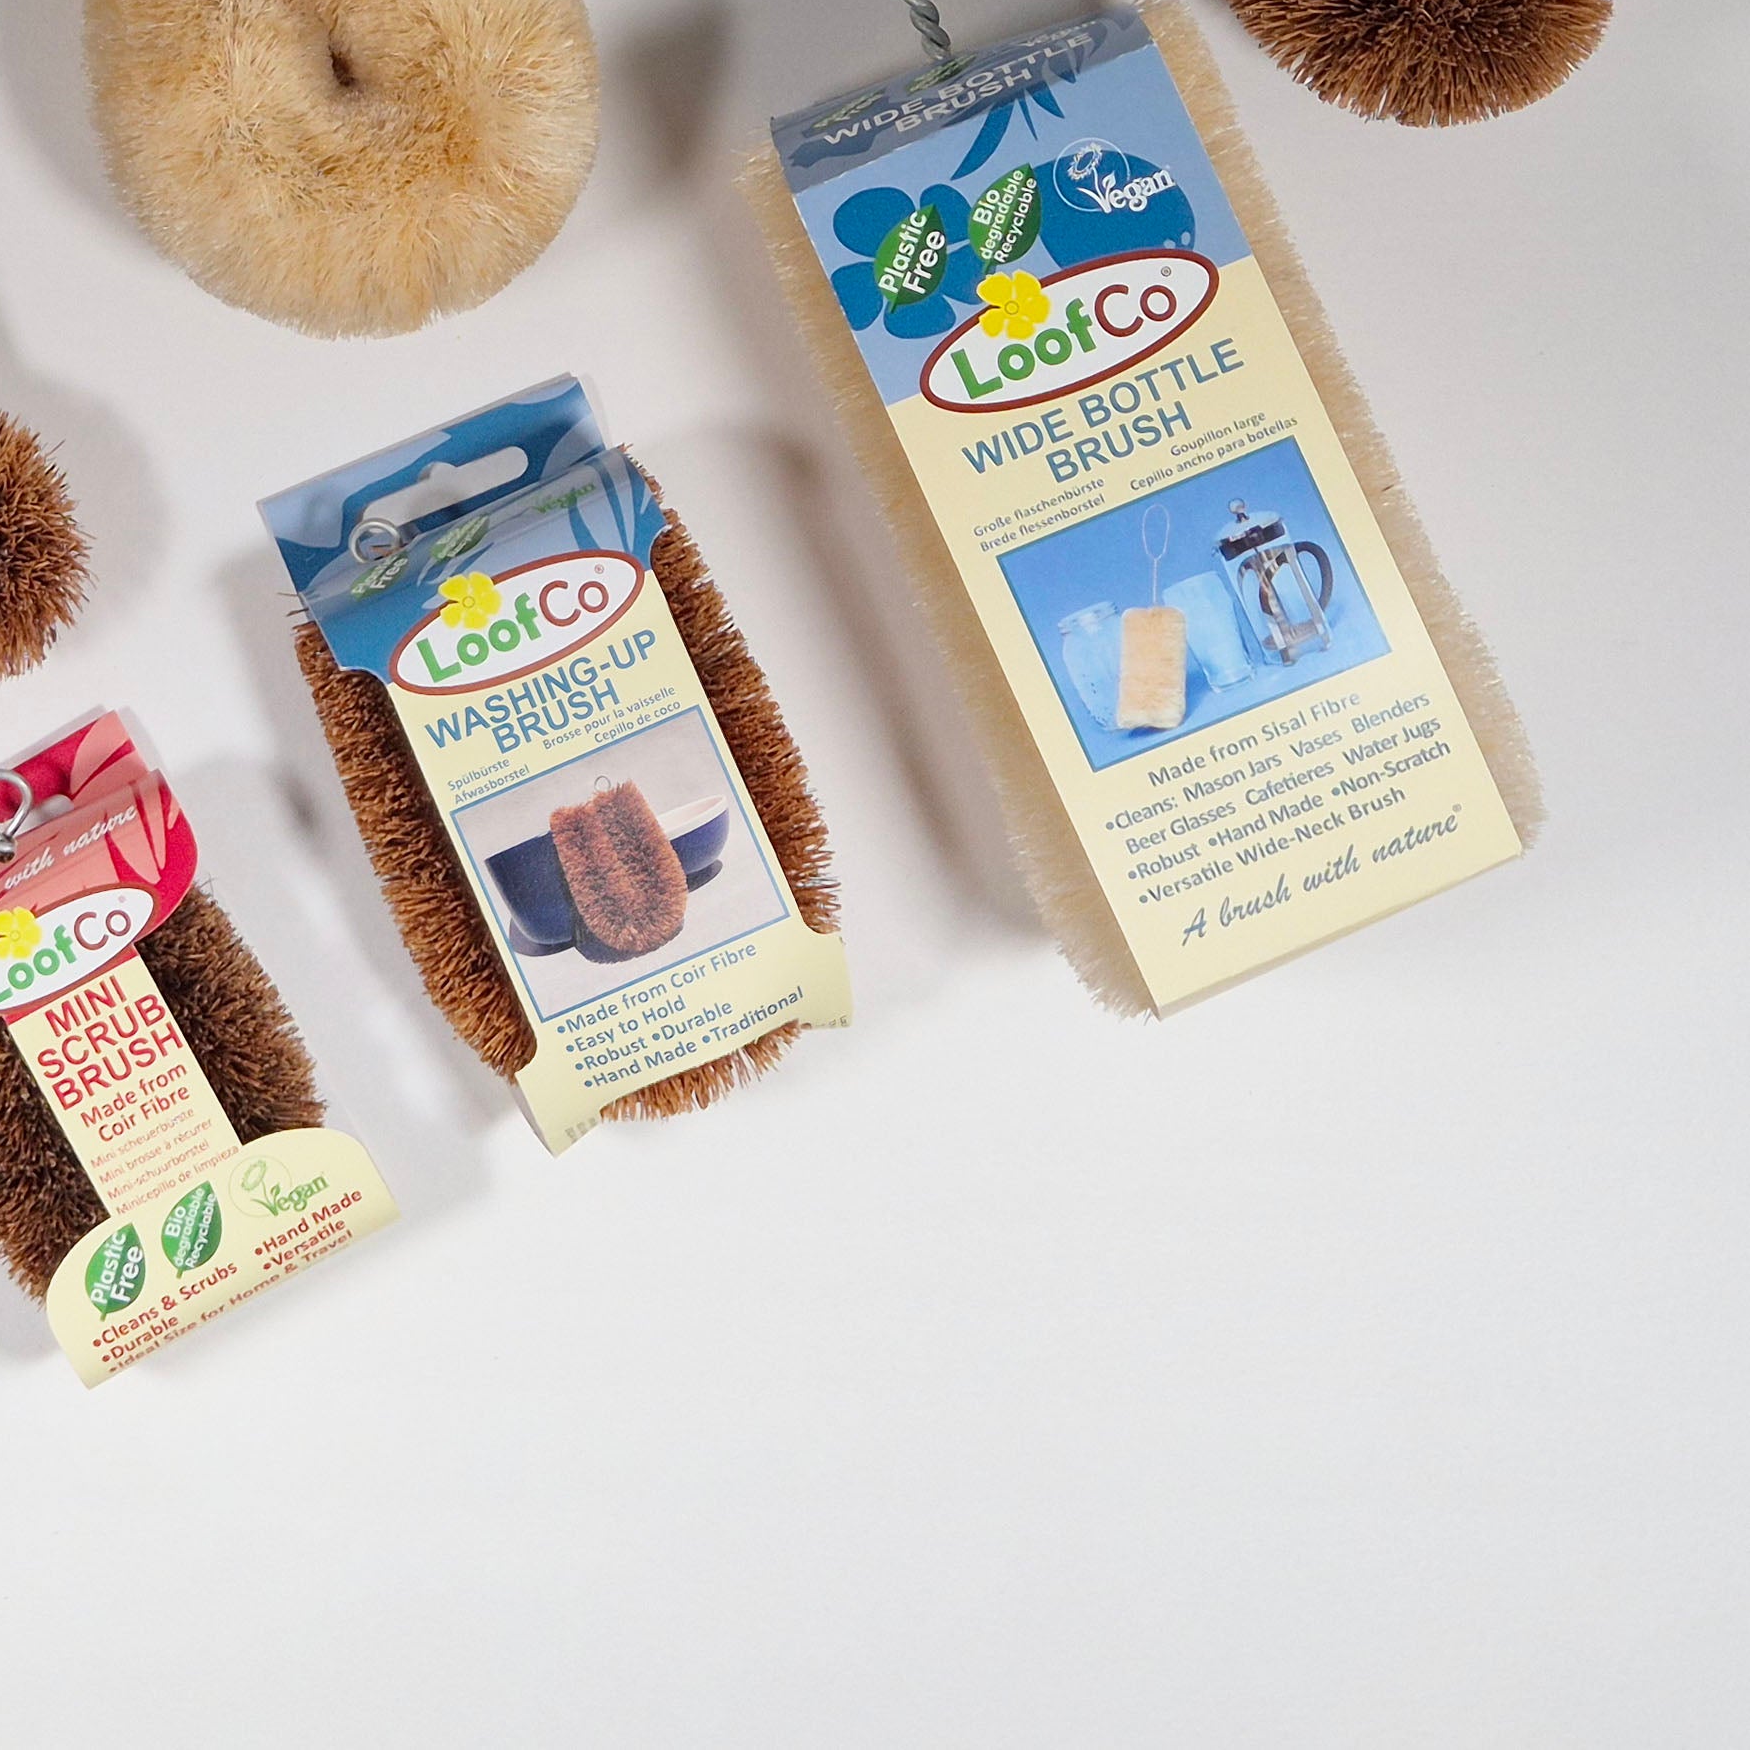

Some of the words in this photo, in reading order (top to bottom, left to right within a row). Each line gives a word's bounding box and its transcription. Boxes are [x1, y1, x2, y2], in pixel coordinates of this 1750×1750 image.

[822, 97, 925, 144] WIDE
[937, 32, 1092, 100] BOTTLE
[895, 68, 1032, 132] BRUSH
[972, 190, 1000, 225] Bio
[980, 170, 1024, 260] degradable
[1077, 157, 1175, 213] Vegan
[879, 211, 927, 293] Plastic
[994, 179, 1037, 263] Recyclable
[905, 230, 945, 294] Free
[961, 408, 1073, 473] WIDE
[1078, 338, 1243, 428] BOTTLE
[1170, 426, 1232, 456] Goupillon
[1232, 412, 1265, 431] large
[1045, 401, 1191, 482] BRUSH
[425, 629, 655, 747] WASHING-UP
[491, 678, 619, 753] BRUSH
[541, 727, 582, 750] Brosse
[583, 714, 611, 734] pour
[612, 708, 625, 719] la
[625, 686, 676, 713] vaisselle
[593, 721, 638, 749] Cepillo
[635, 713, 652, 726] de
[653, 701, 681, 718] coco
[1147, 755, 1206, 787] Made
[1209, 734, 1259, 763] from
[1260, 710, 1307, 742] Sisal
[1309, 694, 1360, 722] Fibre
[447, 758, 510, 791] Spülbürste
[454, 763, 530, 805] Afwasborstel
[1125, 828, 1167, 855] Beer
[1169, 801, 1236, 836] Glasses
[1244, 761, 1334, 805] Cafetieres
[1341, 734, 1398, 765] Water
[1401, 717, 1441, 743] Jugs
[0, 846, 55, 889] with
[62, 805, 138, 856] nature
[1181, 907, 1207, 947] A
[1219, 873, 1292, 927] brush
[1302, 843, 1361, 892] with
[44, 976, 125, 1037] MINI
[621, 983, 667, 1010] from
[669, 964, 706, 988] Coir
[709, 944, 757, 972] Fibre
[37, 994, 165, 1079] SCRUB
[52, 1022, 182, 1110] BRUSH
[80, 1090, 137, 1127] Made
[138, 1064, 187, 1096] from
[98, 1113, 136, 1142] Coir
[139, 1086, 190, 1120] Fibre
[98, 1168, 123, 1184] Mini
[124, 1145, 162, 1171] brosse
[256, 1175, 328, 1217] Vegan
[90, 1231, 126, 1304] Plastic
[112, 1246, 148, 1302] Free
